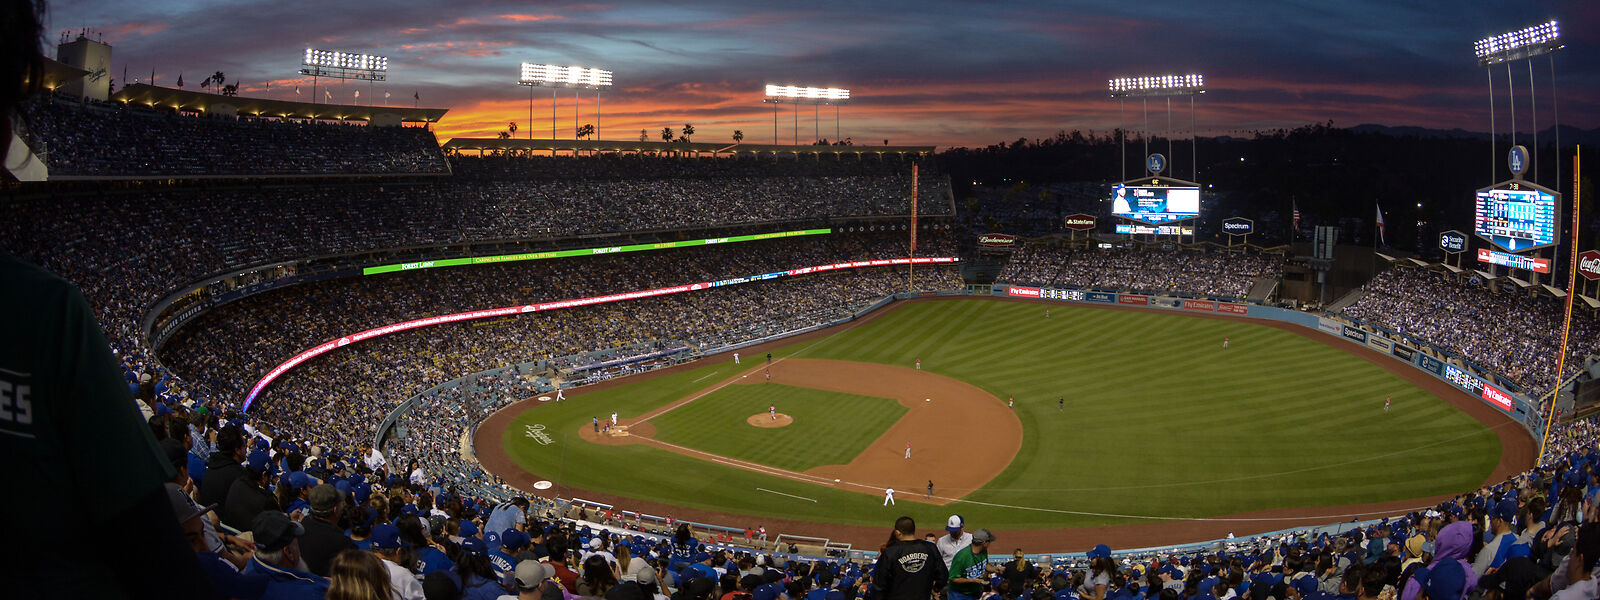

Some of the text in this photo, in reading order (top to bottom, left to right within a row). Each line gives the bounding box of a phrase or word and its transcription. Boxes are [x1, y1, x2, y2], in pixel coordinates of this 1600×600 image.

[1512, 150, 1521, 171] LA
[1224, 222, 1249, 230] Spectrum
[980, 236, 1013, 244] Budweiser
[1344, 328, 1364, 340] Spectrum
[1484, 386, 1512, 407] Fly Emirates
[525, 424, 556, 446] Dodgers
